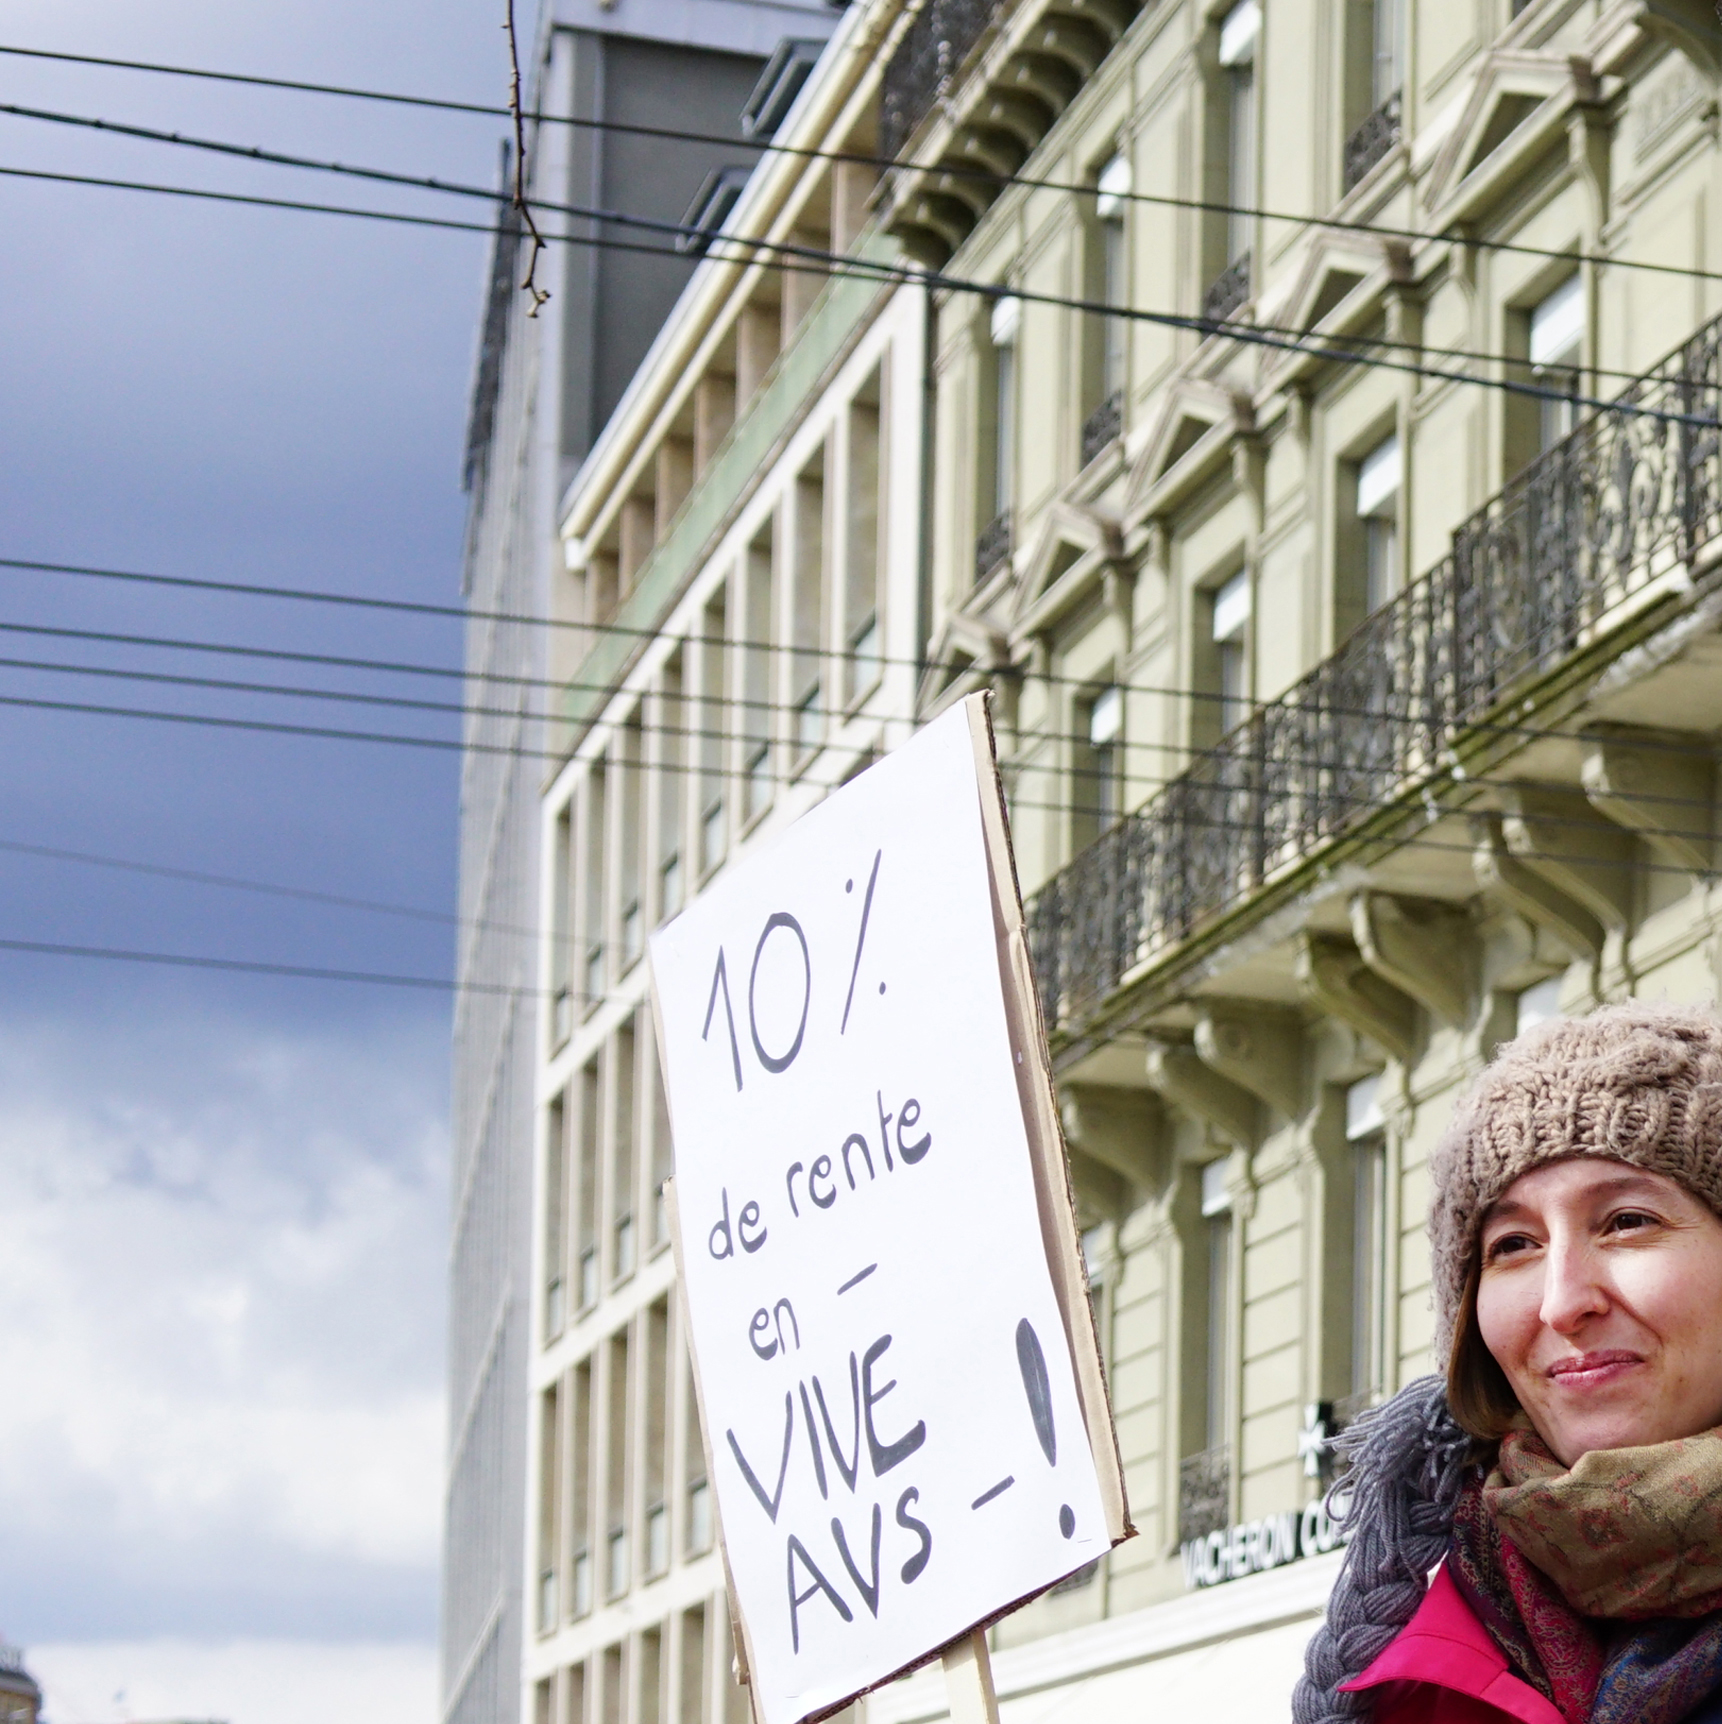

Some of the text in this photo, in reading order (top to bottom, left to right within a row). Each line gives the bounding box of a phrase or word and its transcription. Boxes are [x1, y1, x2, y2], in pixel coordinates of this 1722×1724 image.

[706, 1090, 934, 1263] de rente
[748, 1297, 799, 1362] en
[724, 1333, 928, 1523] VIVE
[787, 1486, 934, 1654] AVS
[1180, 1511, 1297, 1591] VACHERON
